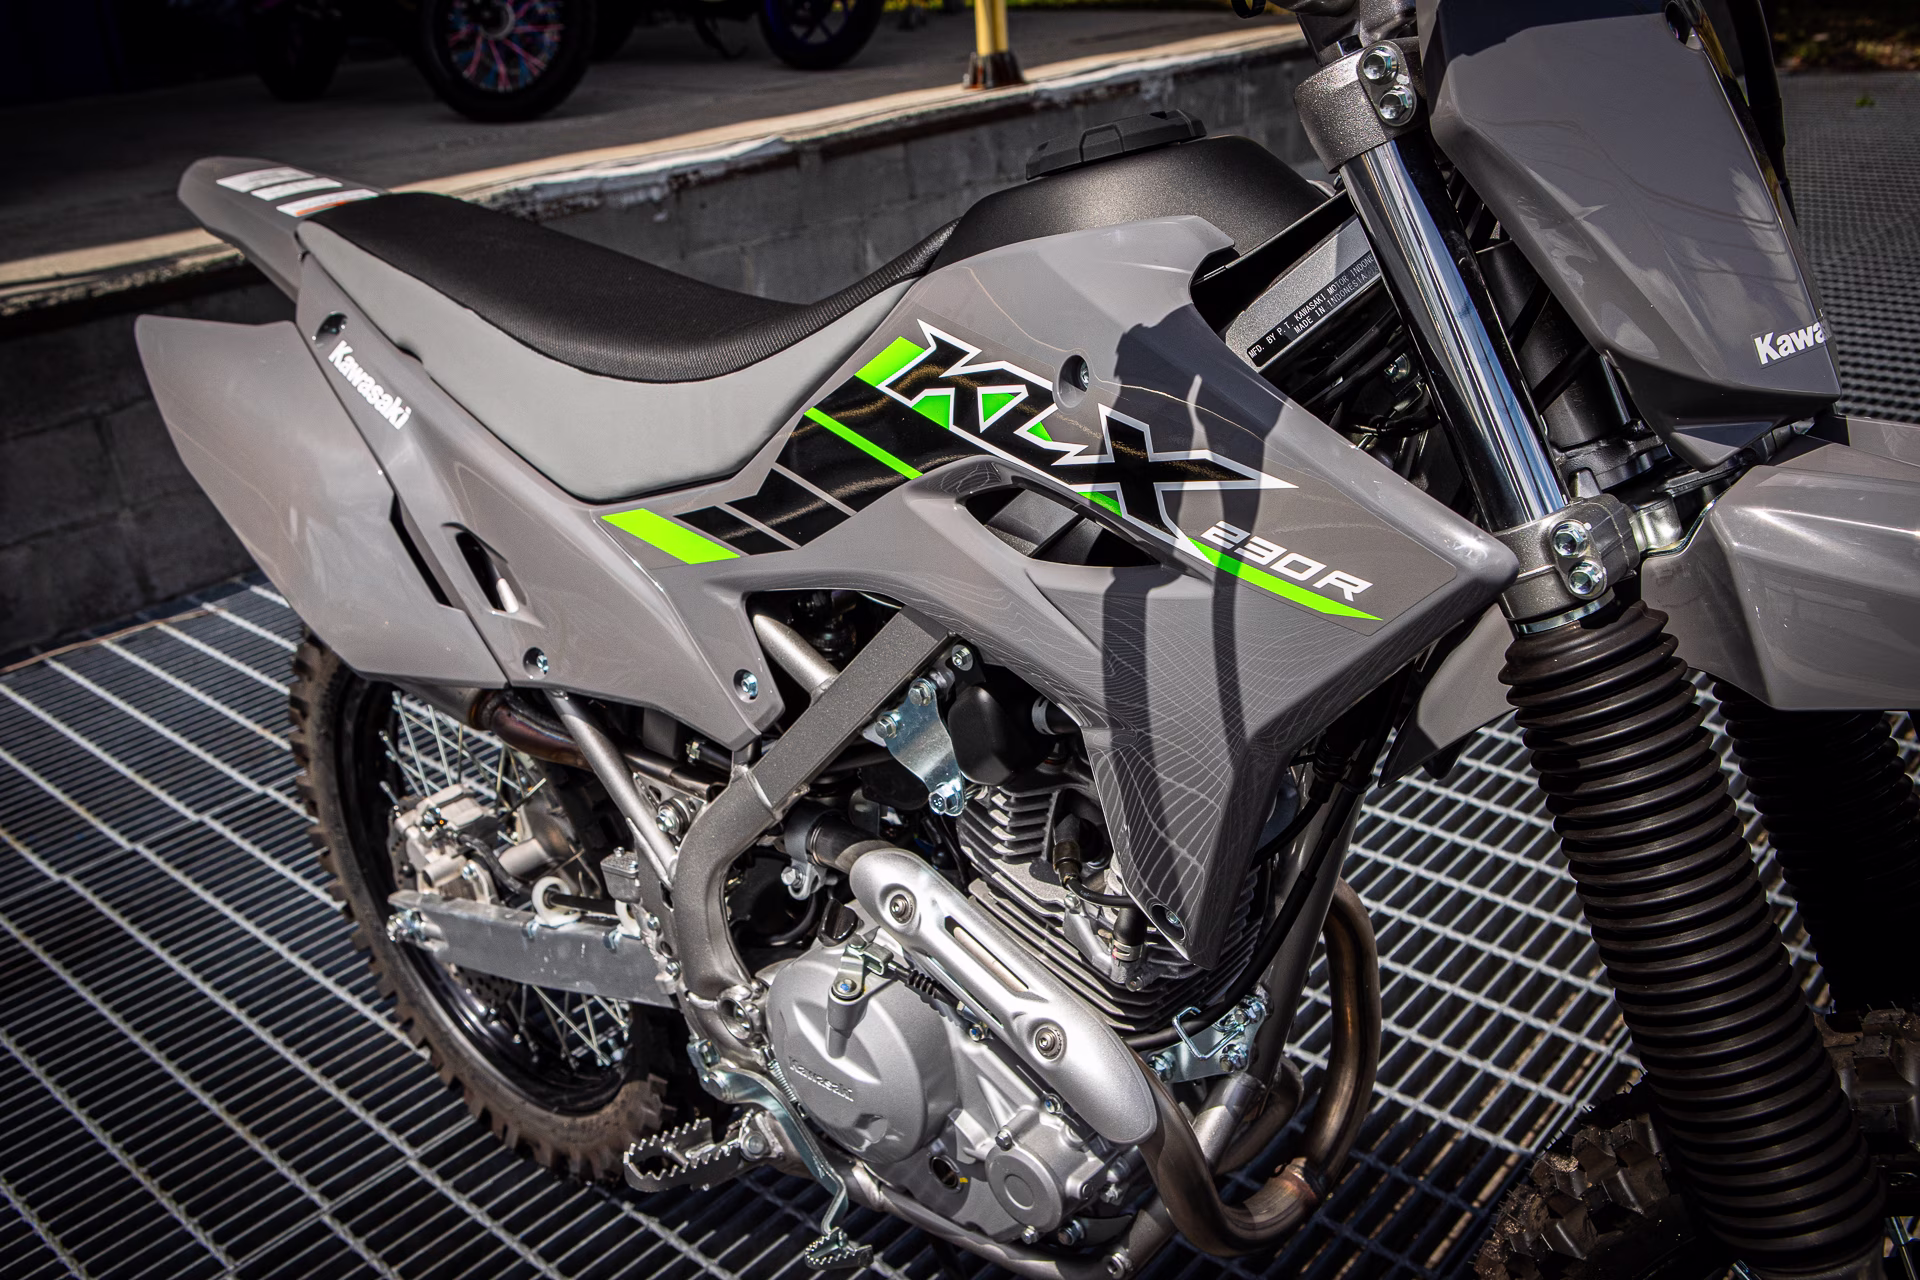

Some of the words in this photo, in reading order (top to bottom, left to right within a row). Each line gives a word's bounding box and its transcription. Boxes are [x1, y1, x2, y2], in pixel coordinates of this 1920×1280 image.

[1248, 344, 1265, 359] MFD.
[1266, 333, 1277, 345] BY
[1293, 293, 1327, 322] KAWASAKI
[1326, 275, 1350, 295] MOTOR
[1350, 253, 1376, 277] INDONE
[1293, 316, 1314, 334] MADE
[1314, 306, 1326, 317] IN
[1327, 273, 1368, 307] INDONESIA
[1753, 321, 1828, 365] Kawa
[328, 340, 412, 430] Kawasaki
[877, 319, 1299, 566] KLX
[1200, 520, 1373, 602] 230R
[788, 1056, 854, 1102] Kawasaki
